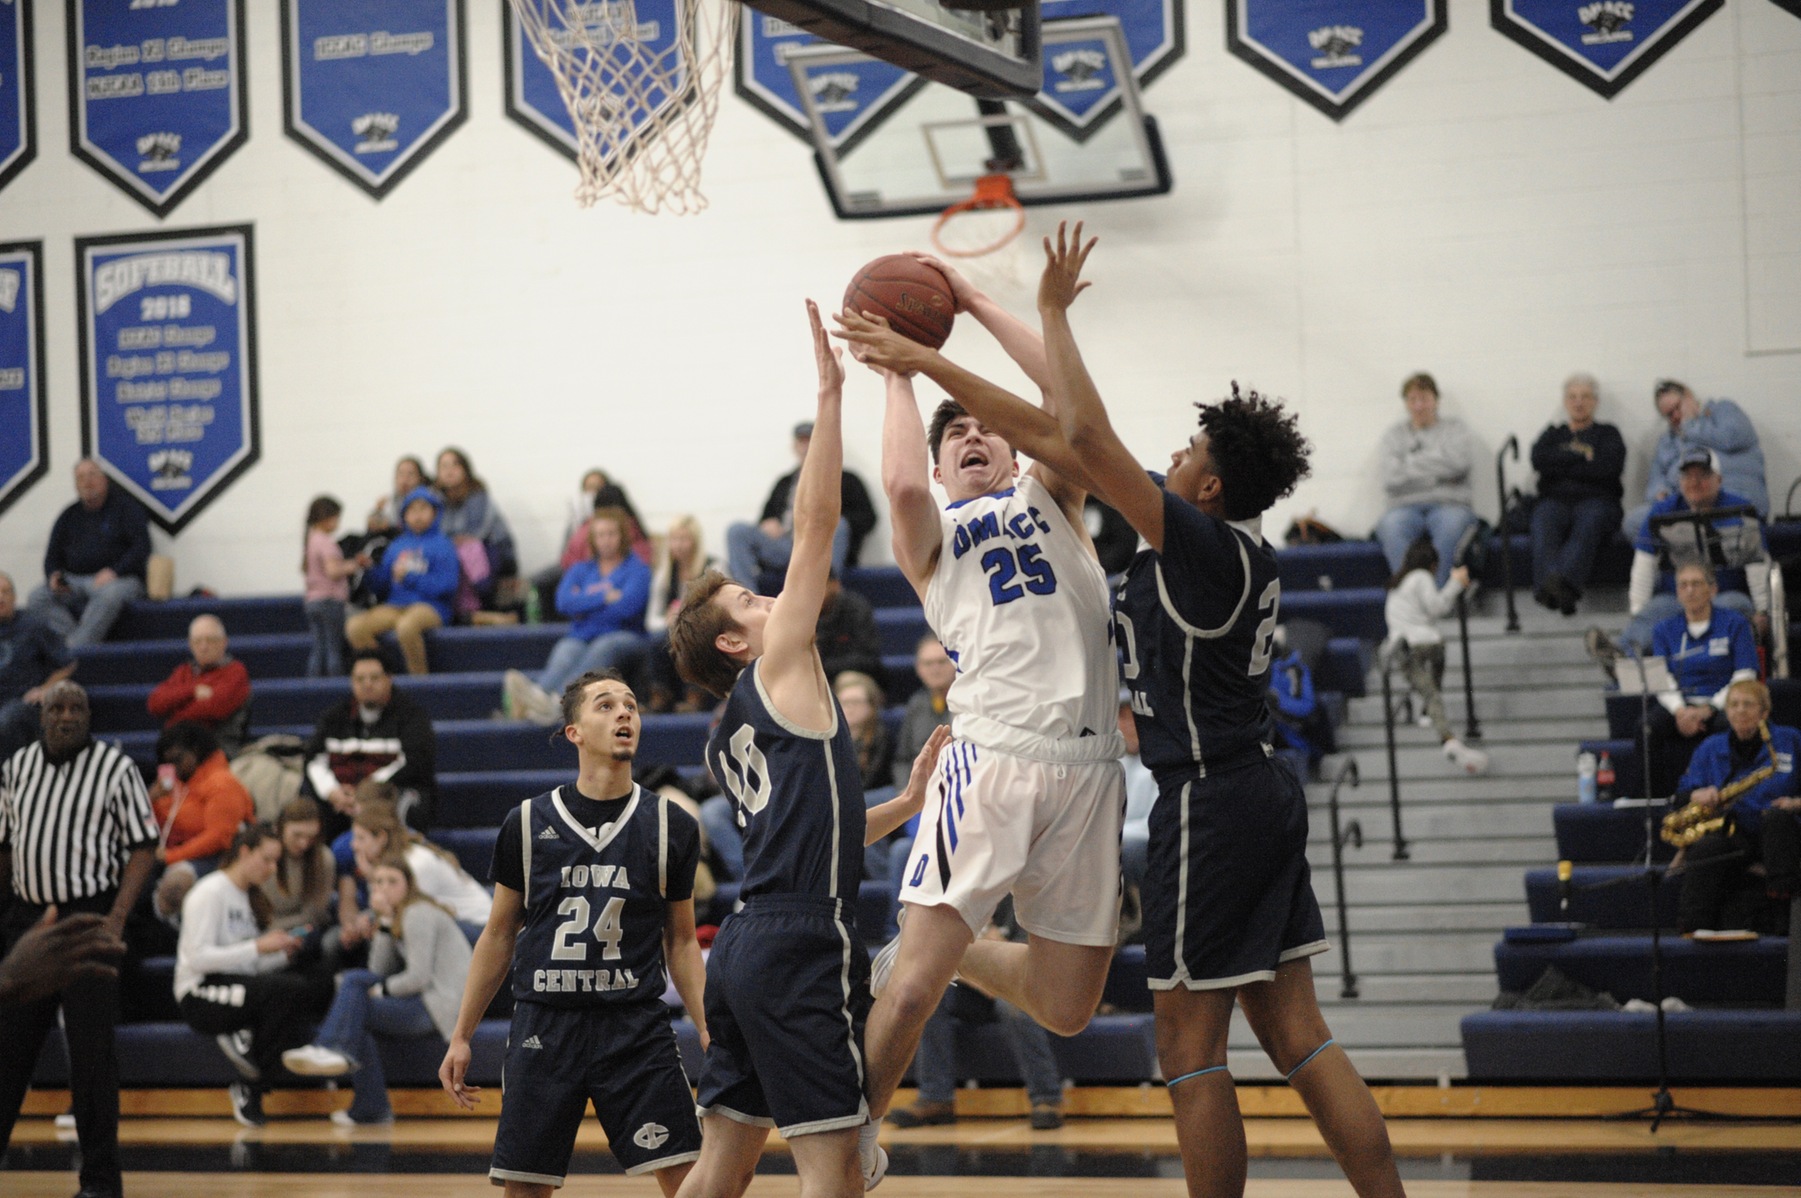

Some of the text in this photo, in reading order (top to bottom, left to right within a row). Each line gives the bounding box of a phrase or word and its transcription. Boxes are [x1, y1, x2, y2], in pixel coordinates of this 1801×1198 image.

[95, 252, 236, 315] SOFTBALL
[981, 543, 1057, 606] 25
[561, 864, 630, 890] IOWA
[550, 896, 626, 960] 24
[533, 968, 639, 992] CENTRAL
